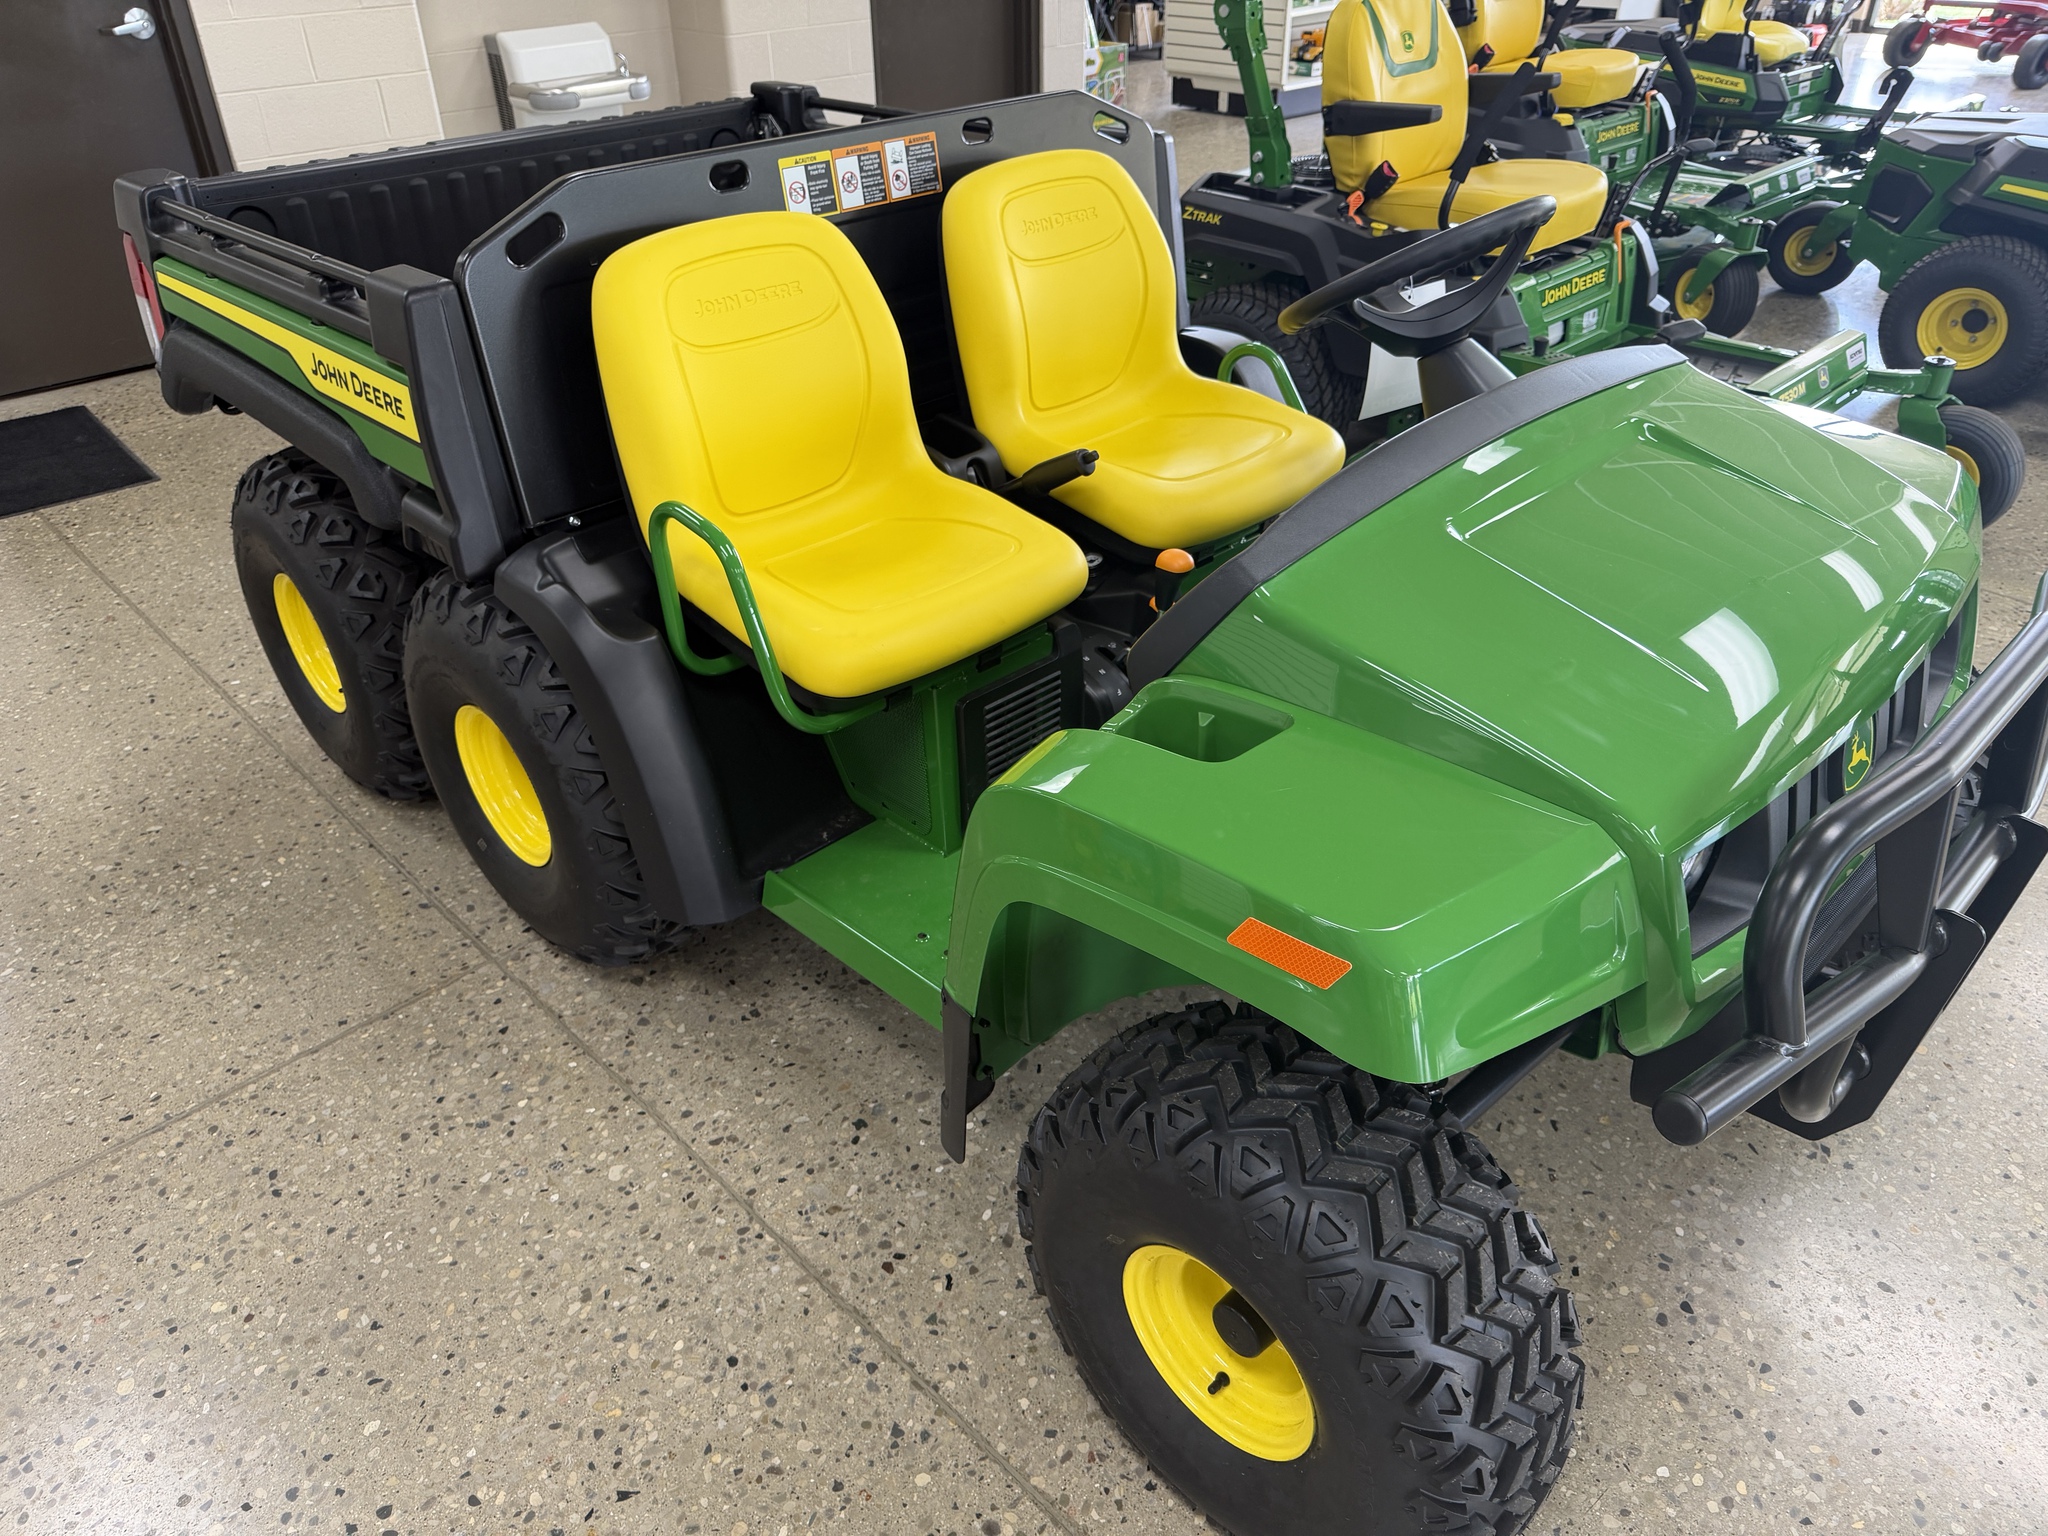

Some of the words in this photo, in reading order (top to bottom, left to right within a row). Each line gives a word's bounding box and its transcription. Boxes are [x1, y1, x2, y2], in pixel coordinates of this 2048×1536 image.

[1714, 76, 1741, 88] DEERE
[1596, 129, 1616, 144] JOHN
[1616, 121, 1640, 138] DEERE
[1021, 216, 1054, 236] JOHN
[1053, 206, 1098, 227] DEERE
[1182, 206, 1222, 226] ZTRAK
[694, 293, 742, 318] JOHN
[741, 280, 804, 306] DEERE
[1541, 283, 1571, 307] JOHN
[1571, 268, 1606, 295] DEERE
[311, 352, 350, 392] JOHN
[349, 370, 406, 421] DEERE
